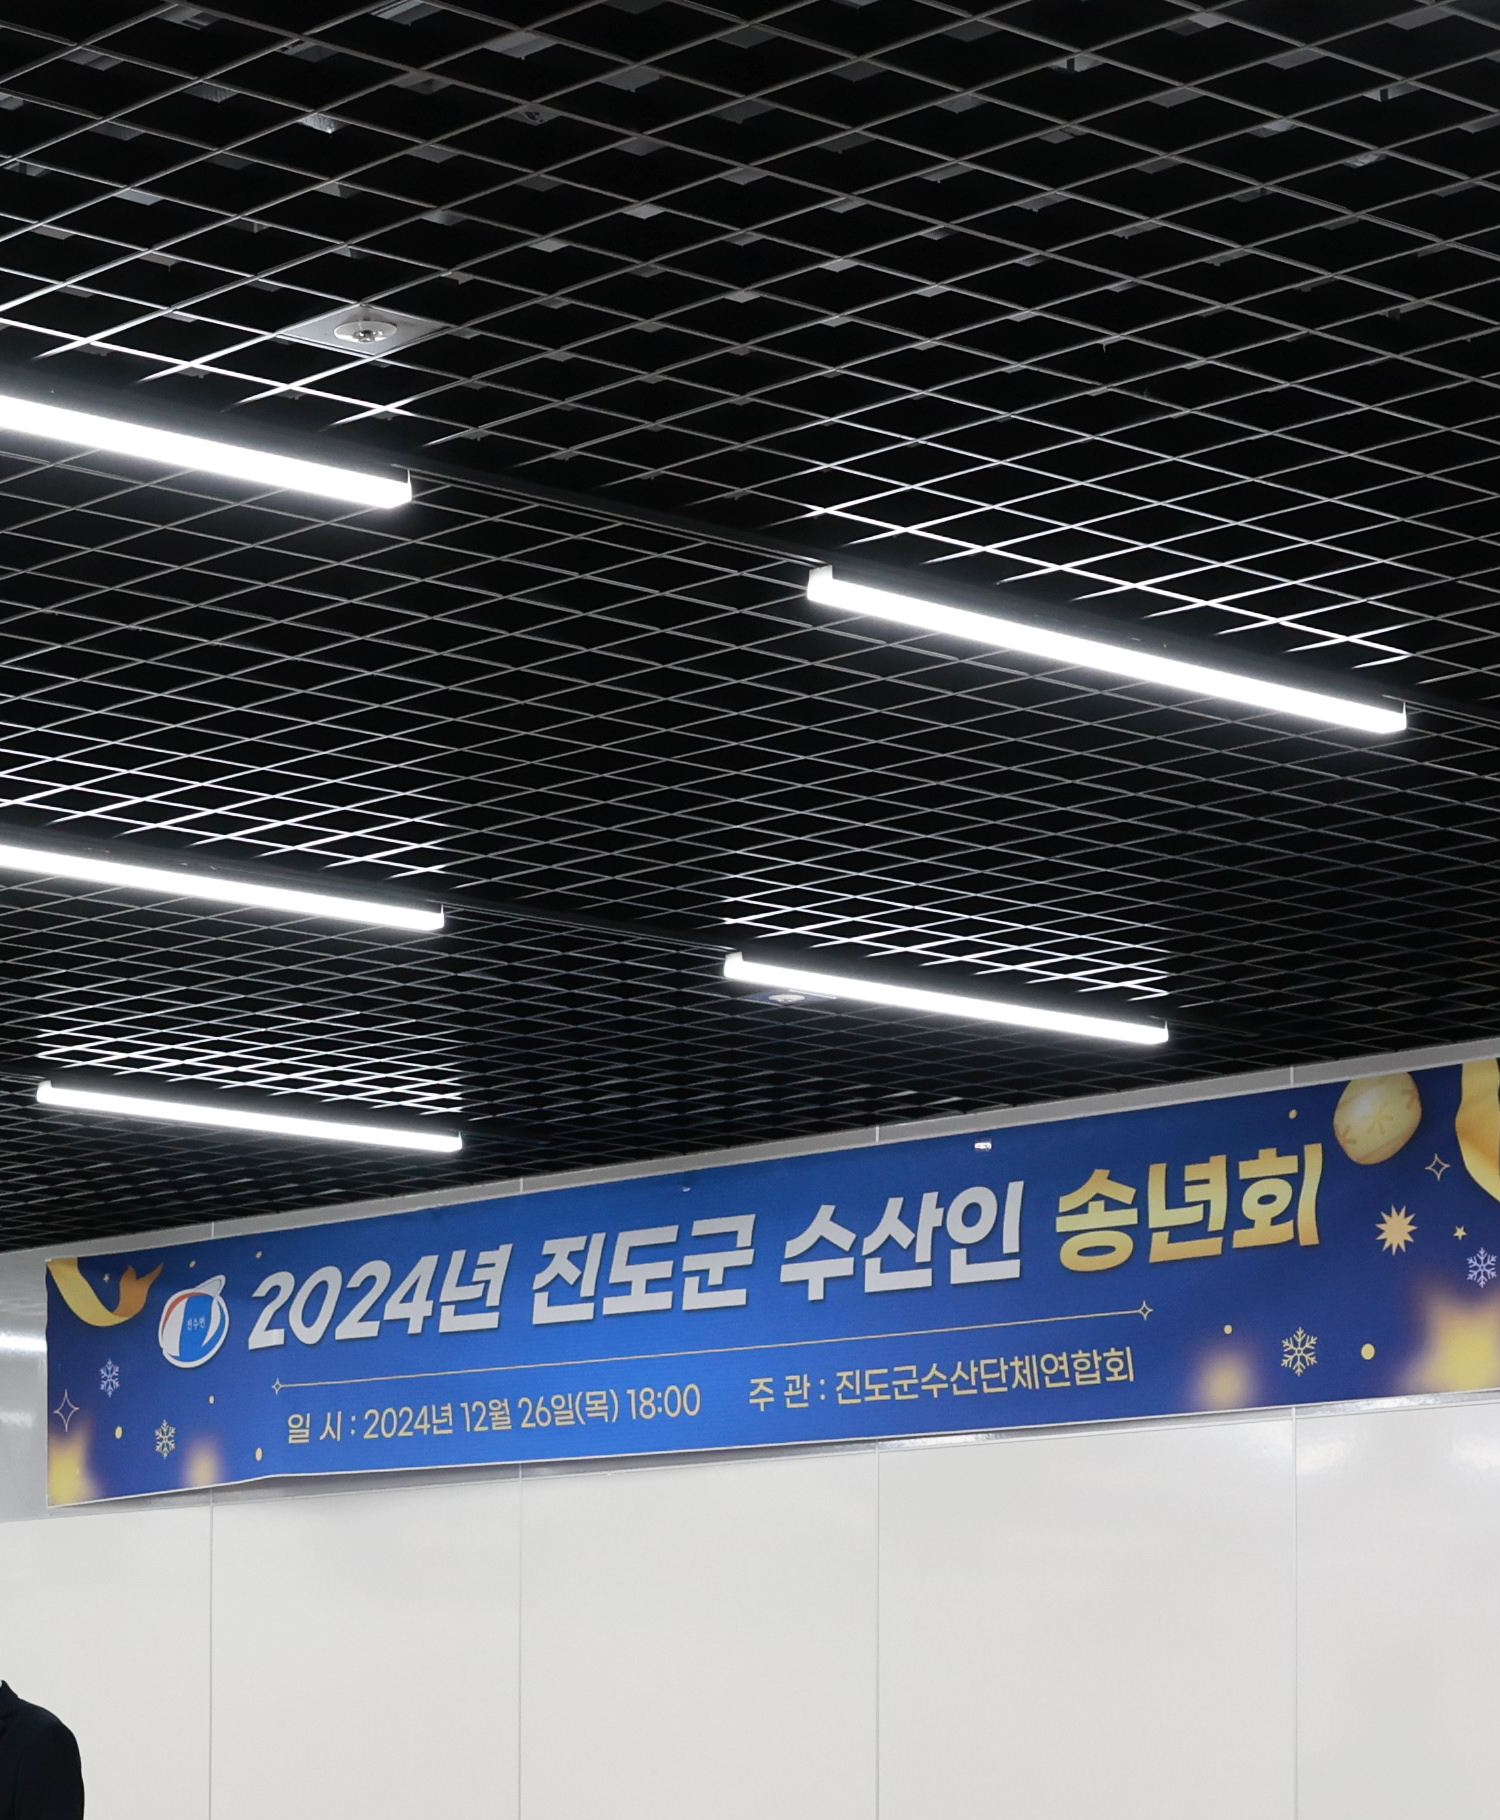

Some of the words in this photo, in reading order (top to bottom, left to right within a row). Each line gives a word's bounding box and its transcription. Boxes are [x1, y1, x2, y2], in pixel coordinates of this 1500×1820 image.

[248, 1243, 513, 1350] 2024년
[532, 1213, 756, 1325] 진도군
[780, 1181, 1024, 1300] 수산인
[1055, 1143, 1323, 1272] 송년회
[288, 1413, 310, 1444] 일
[363, 1404, 453, 1439] 2024년
[460, 1398, 512, 1433] 12월
[520, 1389, 620, 1430] 26일(목)
[628, 1383, 701, 1420] 18:00
[749, 1376, 776, 1411] 주
[835, 1347, 1135, 1405] 진도군수산단체연합회
